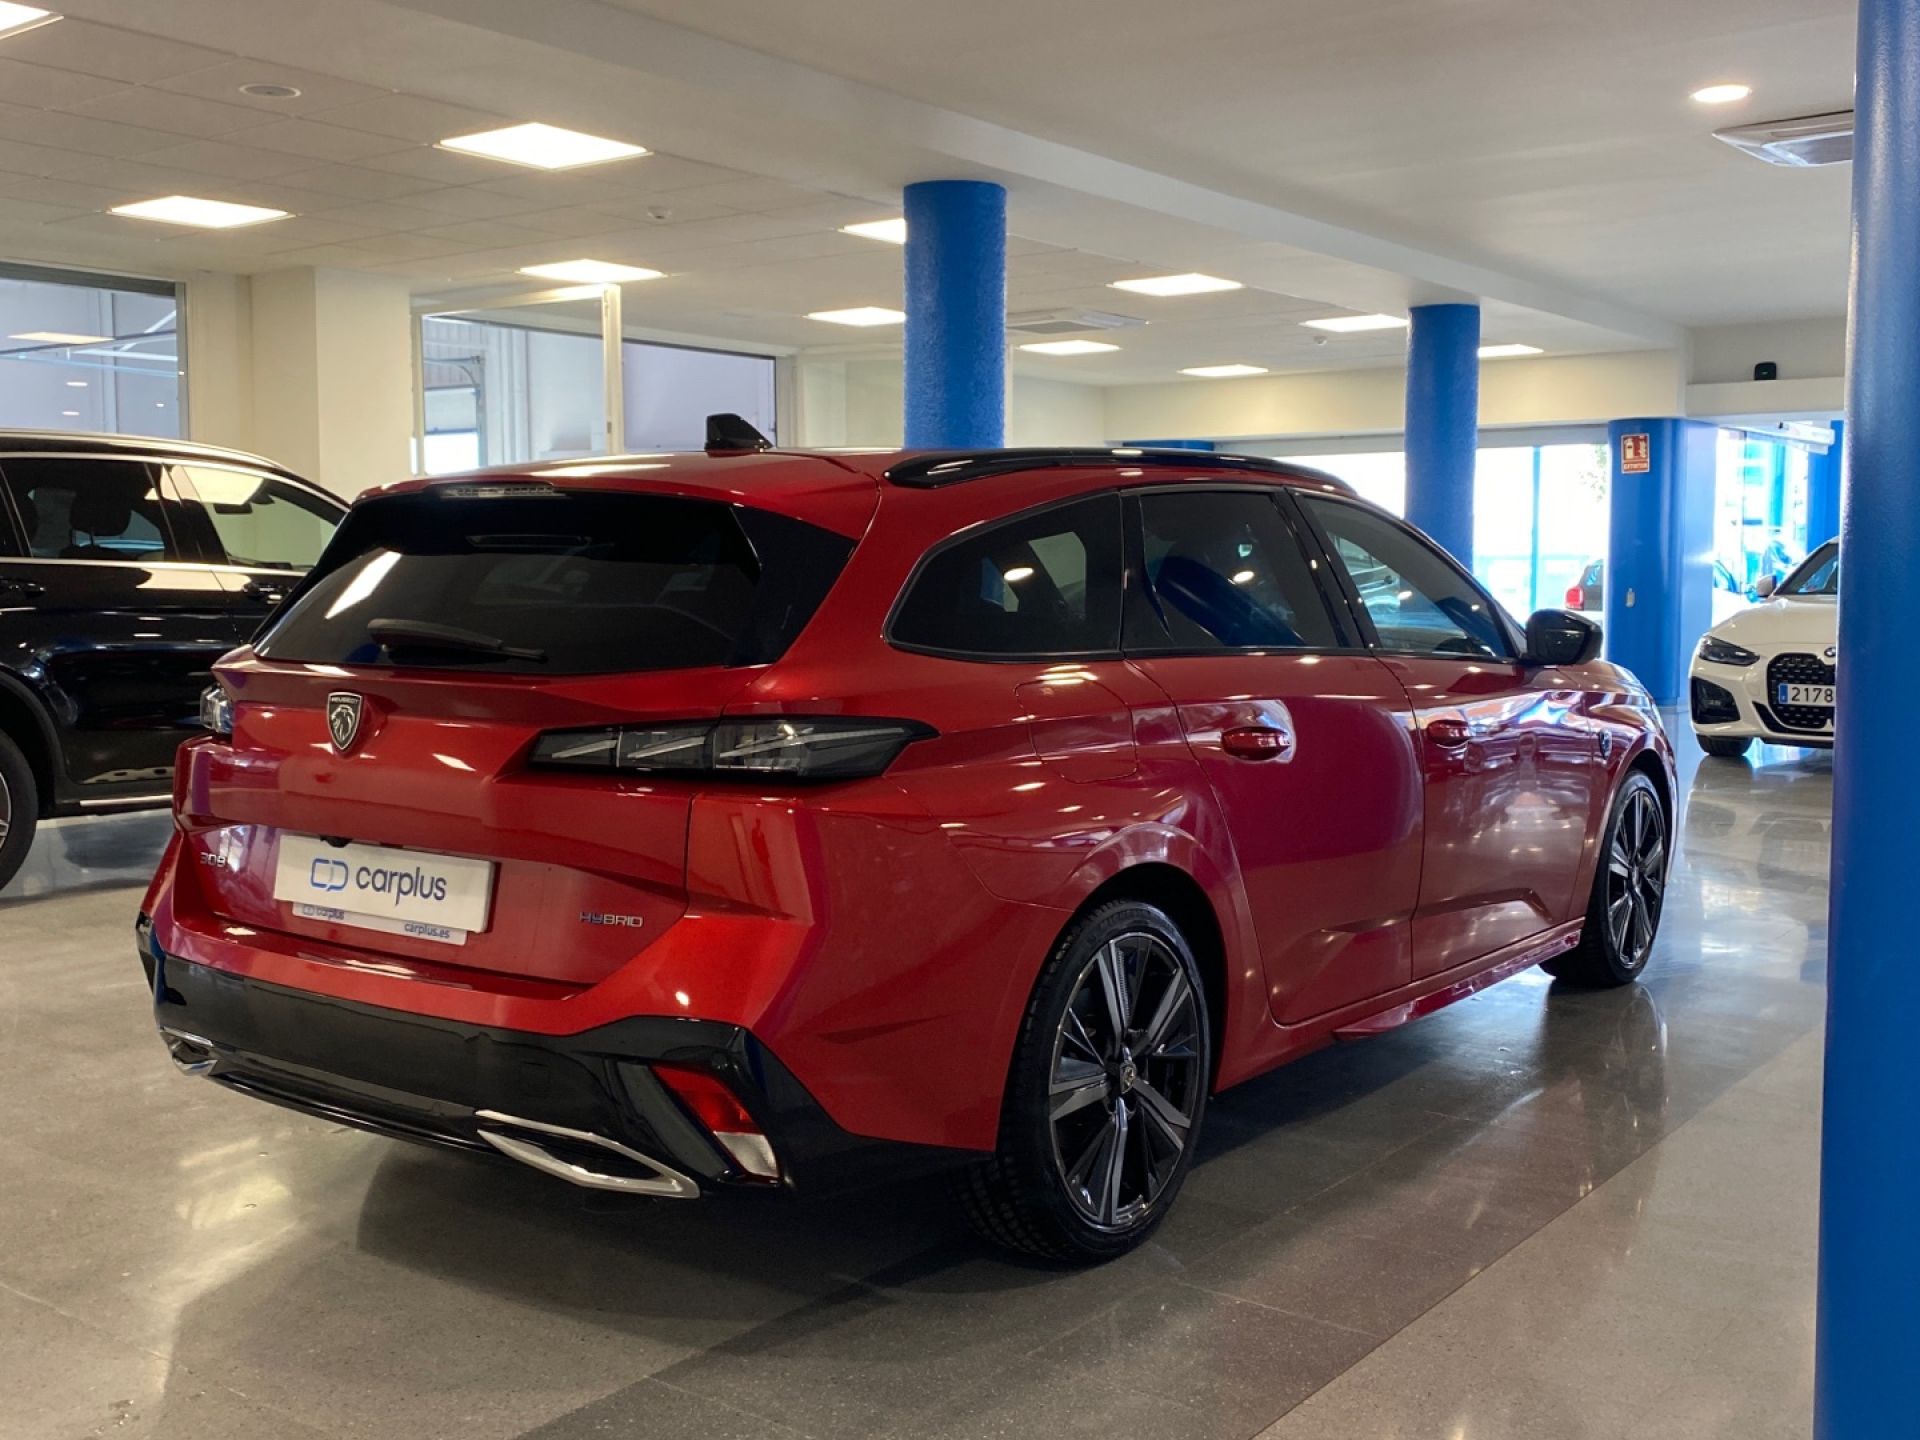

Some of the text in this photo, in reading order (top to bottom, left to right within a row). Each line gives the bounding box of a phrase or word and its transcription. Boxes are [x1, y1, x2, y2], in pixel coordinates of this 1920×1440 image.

[1791, 687, 1833, 703] 2178
[355, 866, 447, 906] carplus
[580, 911, 644, 928] HYBRID
[404, 922, 450, 939] carplus.es
